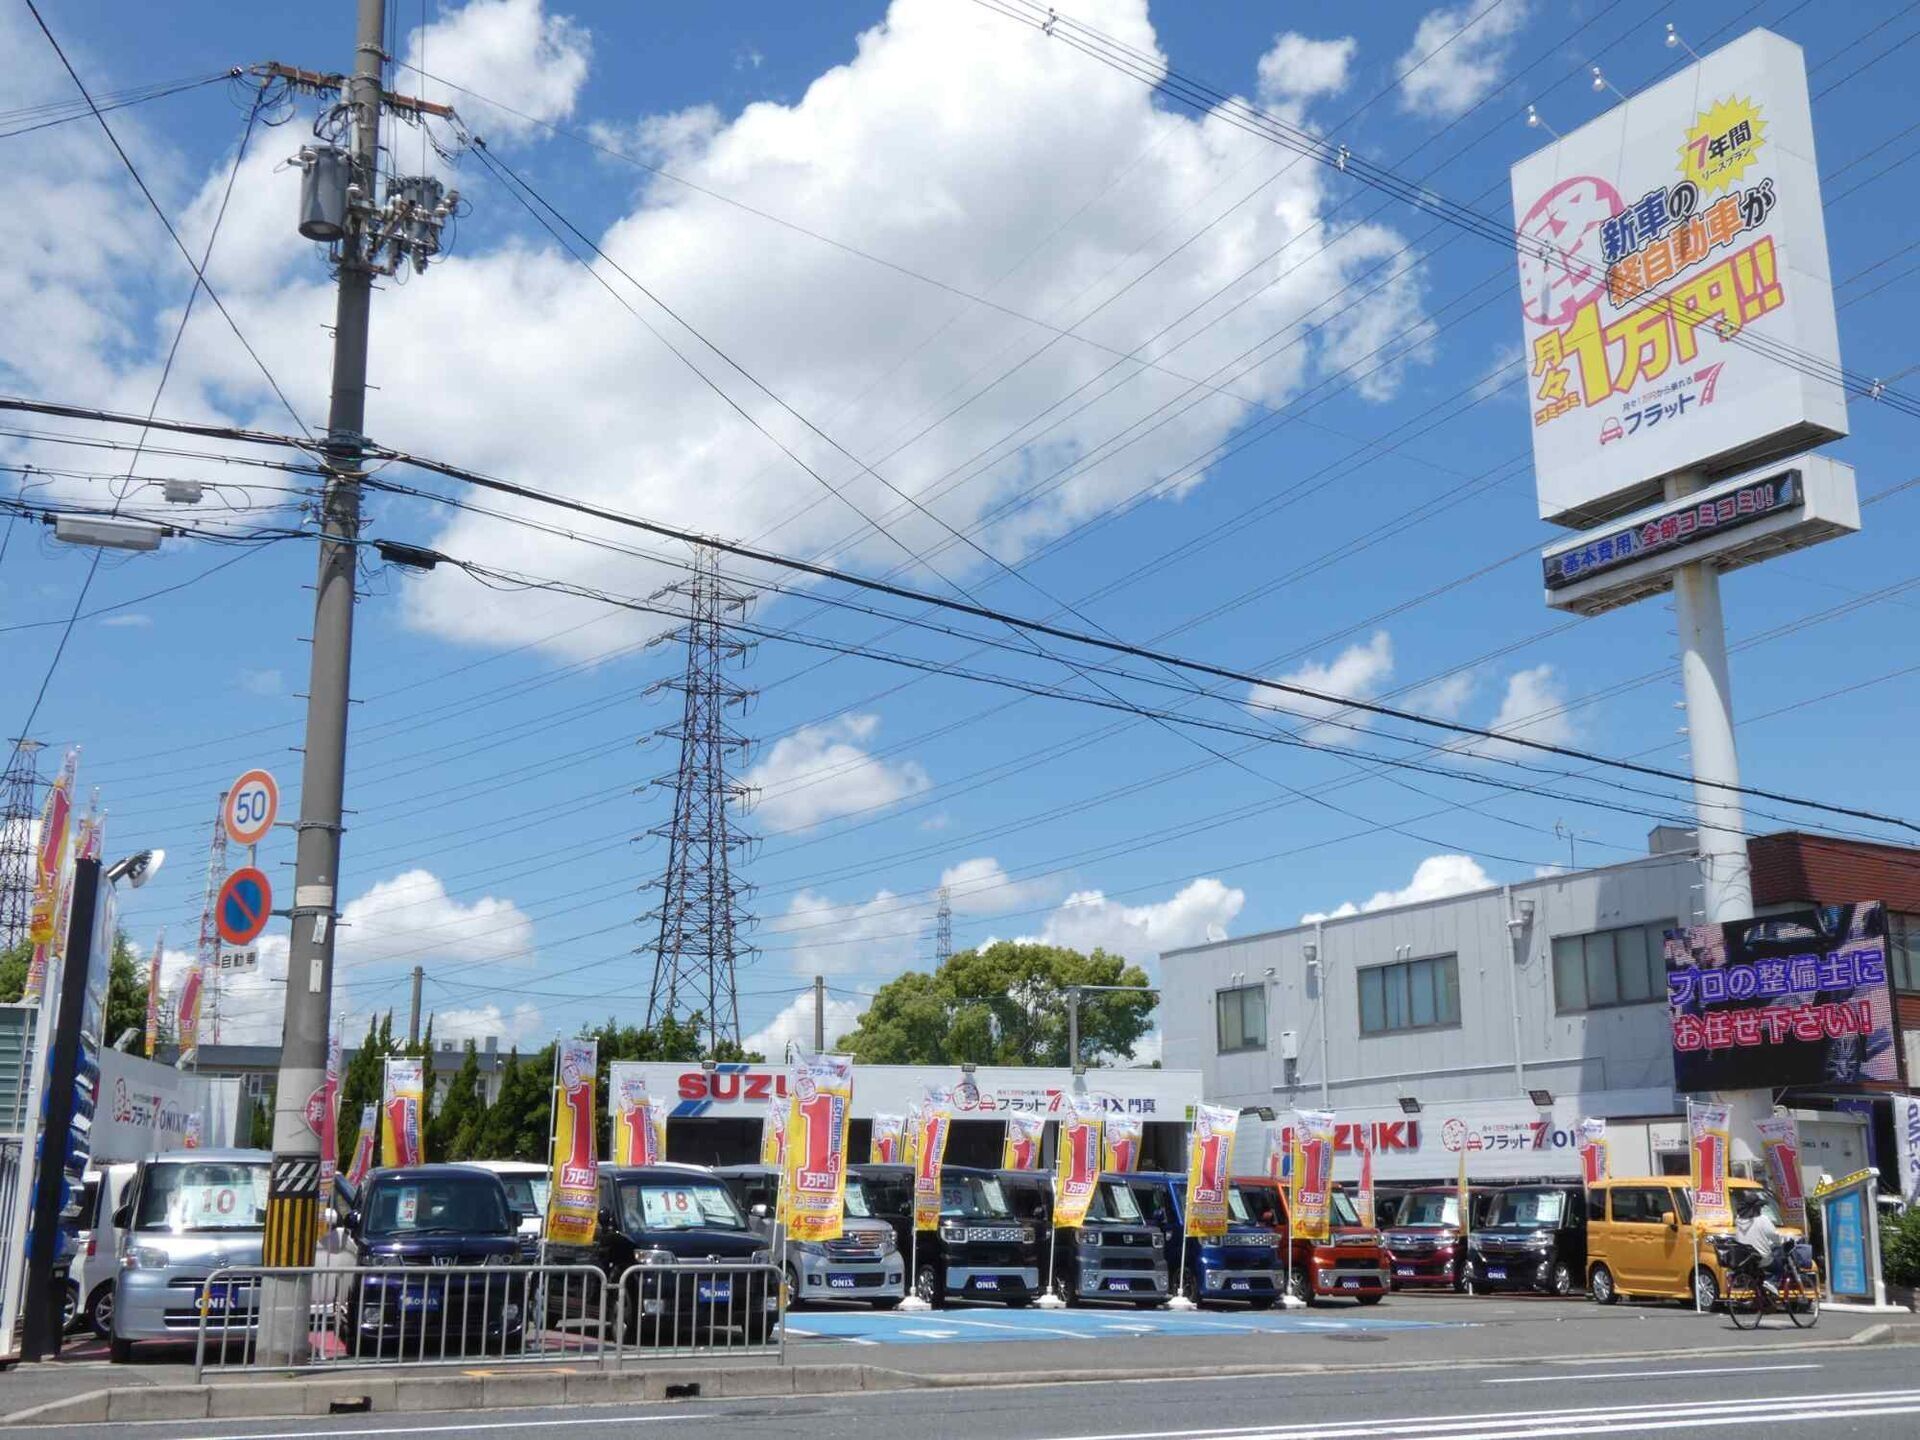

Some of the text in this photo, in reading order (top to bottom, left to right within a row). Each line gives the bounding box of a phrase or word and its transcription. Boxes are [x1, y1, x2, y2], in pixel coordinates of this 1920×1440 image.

[1688, 120, 1751, 169] 7年間
[1702, 148, 1751, 180] リースプラン
[1602, 181, 1698, 262] 新車の
[1607, 179, 1775, 307] 軽自動車が
[1533, 328, 1570, 399] 月々
[1535, 391, 1580, 427] コミコミ
[236, 791, 266, 824] 50
[222, 952, 255, 968] 自動車
[1669, 950, 1885, 1005] プロの整備士に
[1674, 1000, 1872, 1052] お任せ下さい!
[567, 1082, 592, 1168] 1
[1128, 1099, 1156, 1113] 門真
[801, 1095, 831, 1172] 1
[1067, 1125, 1088, 1182] 1
[564, 1168, 590, 1185] 万円
[803, 1172, 829, 1187] 万円
[1200, 1135, 1221, 1190] 1
[1301, 1139, 1322, 1192] 1
[1695, 1135, 1715, 1192] 1
[202, 1189, 236, 1214] 10
[661, 1191, 688, 1211] 18
[832, 1279, 855, 1288] ONIX
[976, 1281, 998, 1289] ONIX
[1109, 1283, 1130, 1291] ONIX
